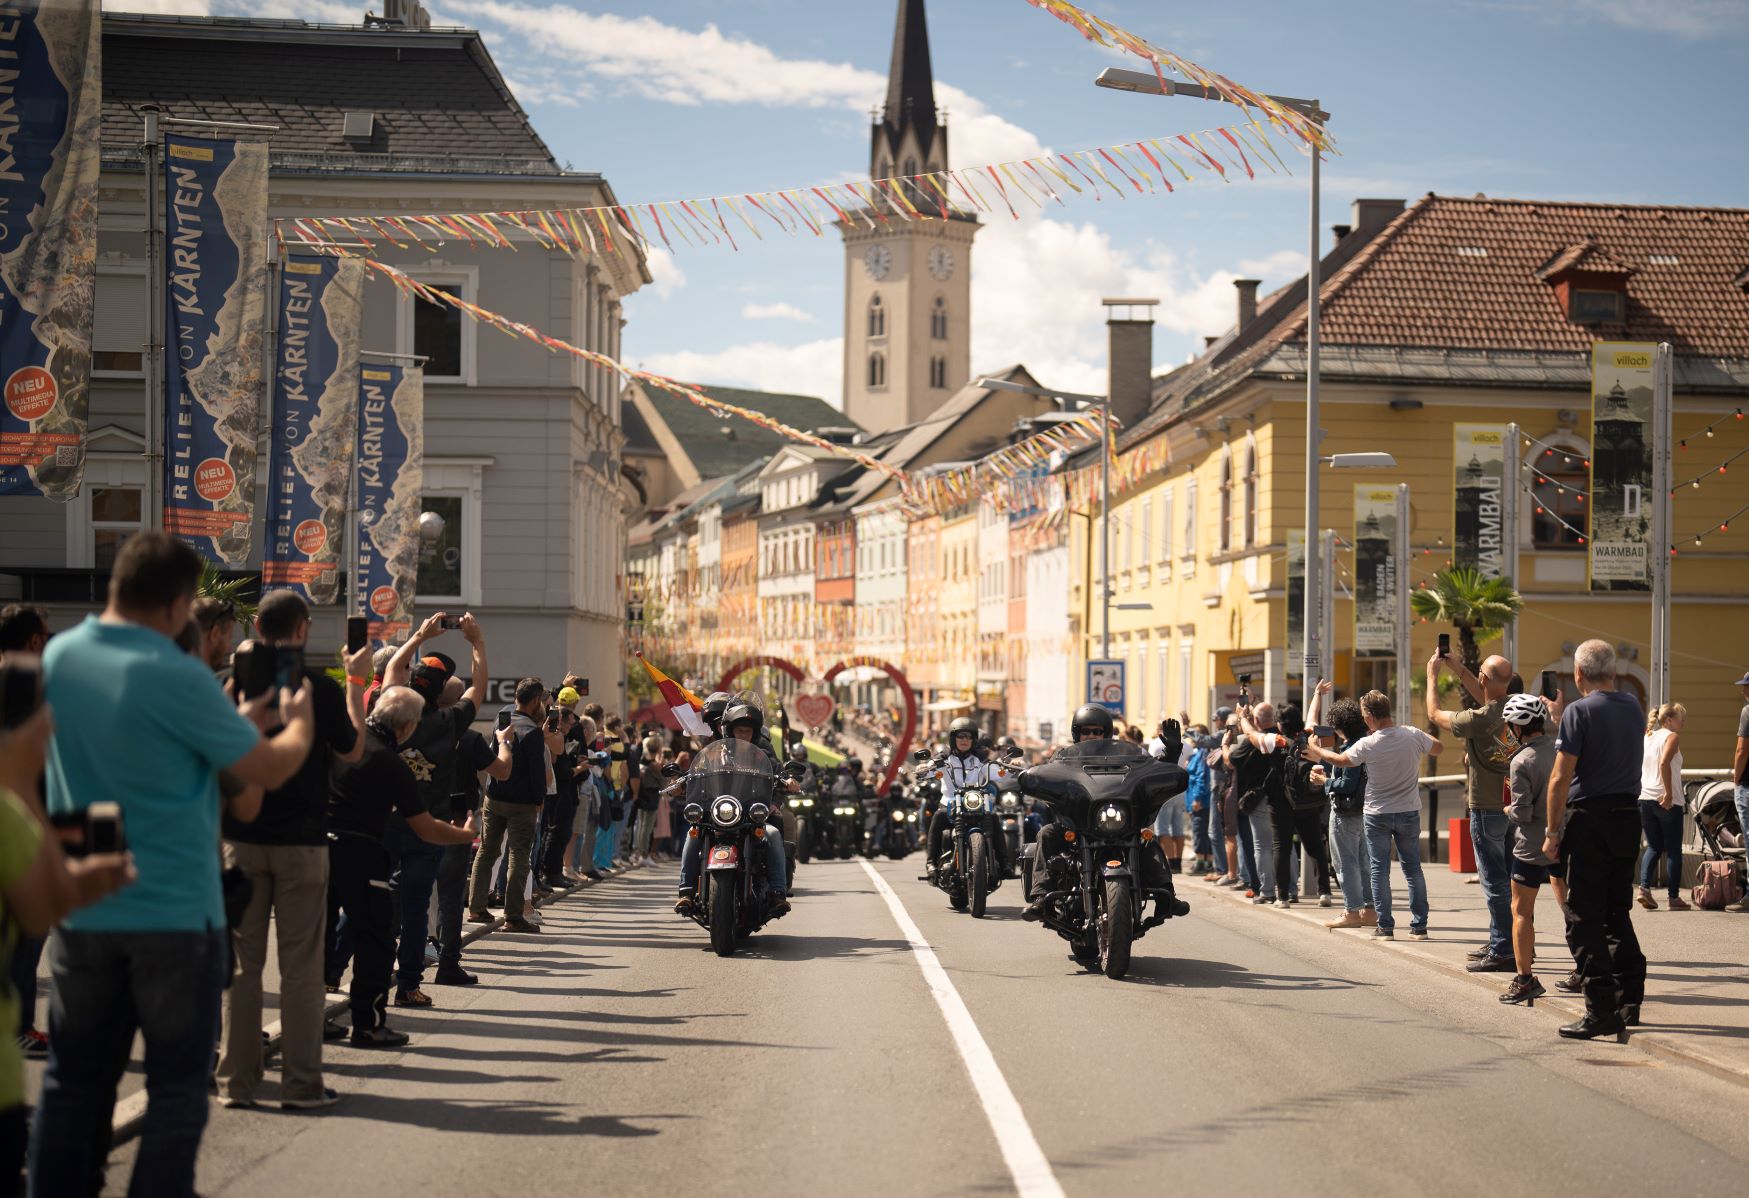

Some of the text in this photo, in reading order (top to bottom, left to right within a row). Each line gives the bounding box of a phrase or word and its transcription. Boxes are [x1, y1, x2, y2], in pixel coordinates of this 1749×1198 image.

[168, 165, 205, 316] KÄRNTEN
[277, 279, 313, 402] KÄRNTEN
[1616, 355, 1648, 366] villach
[12, 376, 46, 396] NEU
[10, 390, 55, 407] MULTIMEDIA
[18, 398, 49, 413] EFFEKTE
[173, 392, 193, 500] RELIEF
[358, 385, 386, 488] KÄRNTEN
[200, 466, 226, 480] NEU
[276, 465, 296, 556] RELIEF
[299, 526, 321, 538] NEU
[1479, 476, 1501, 581] WARMBAD
[1595, 546, 1644, 557] WARMBAD
